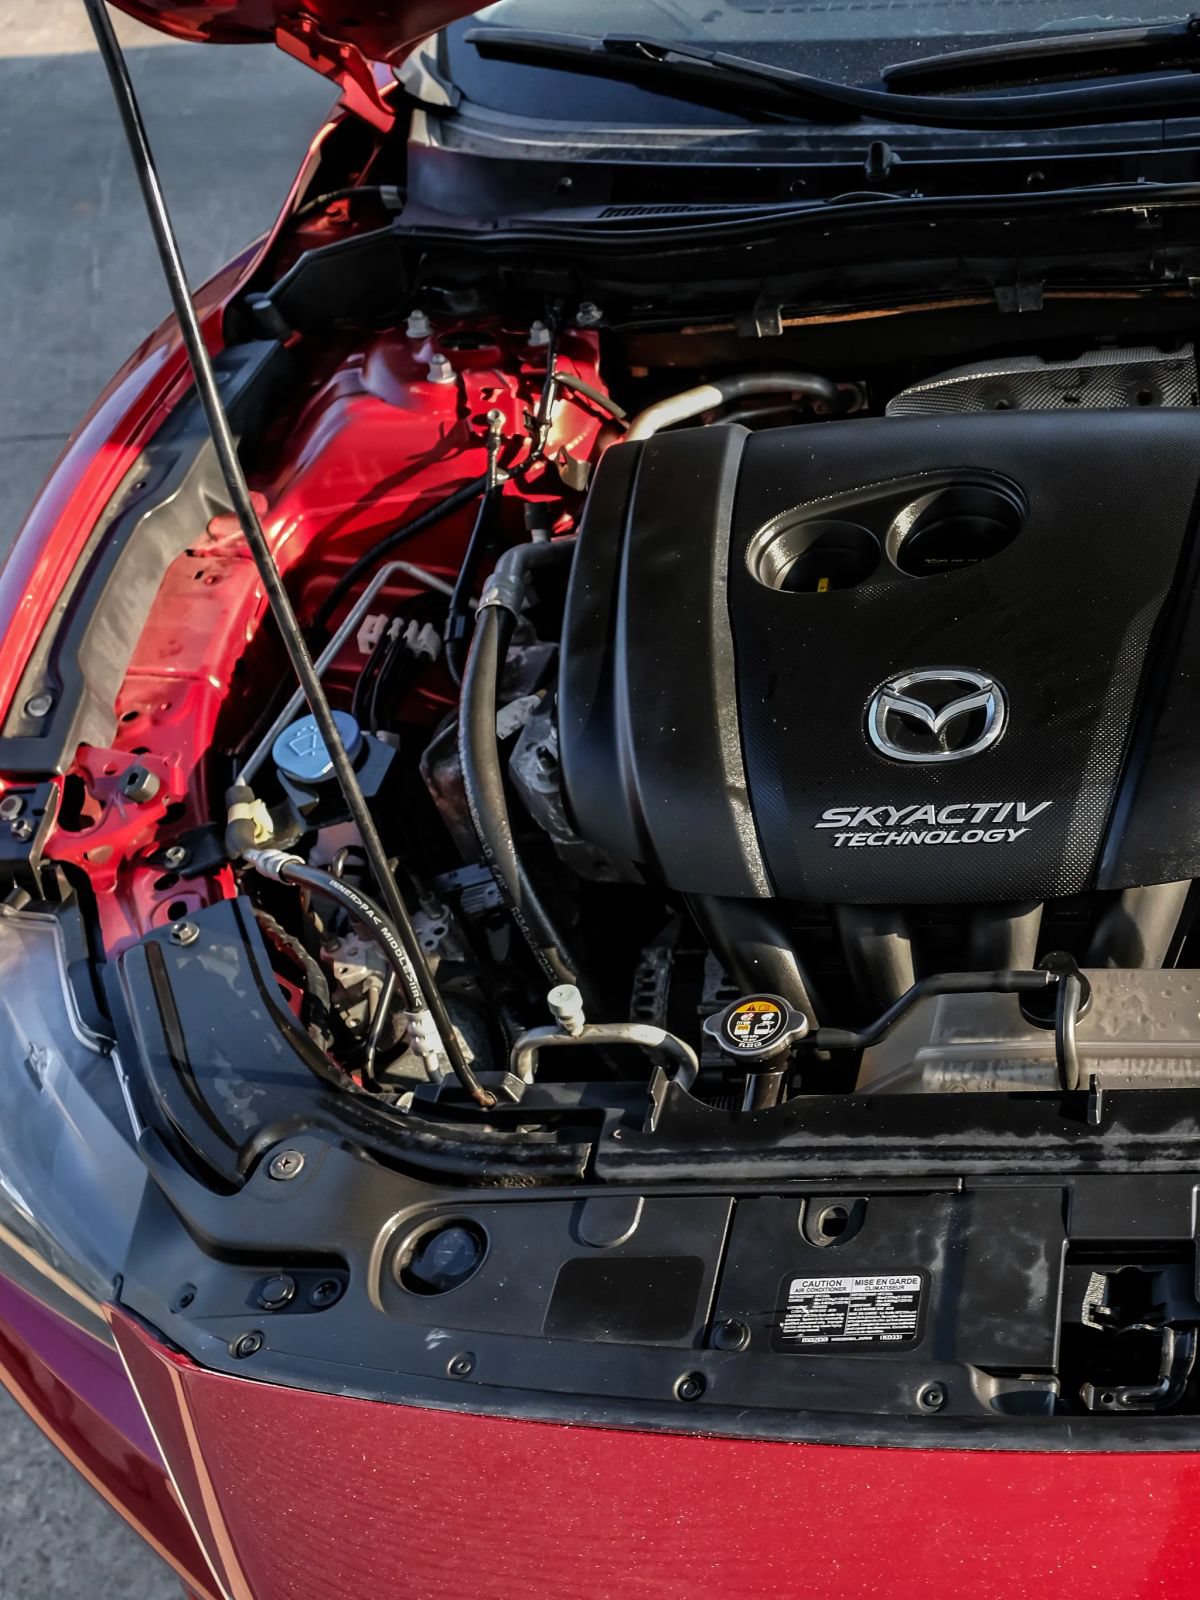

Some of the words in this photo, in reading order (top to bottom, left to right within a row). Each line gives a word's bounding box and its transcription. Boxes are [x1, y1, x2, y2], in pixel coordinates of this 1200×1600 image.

[814, 801, 1054, 829] SKYACTIV
[833, 827, 1032, 848] TECHNOLOGY
[802, 1280, 843, 1288] CAUTION
[888, 1277, 918, 1285] GARDE
